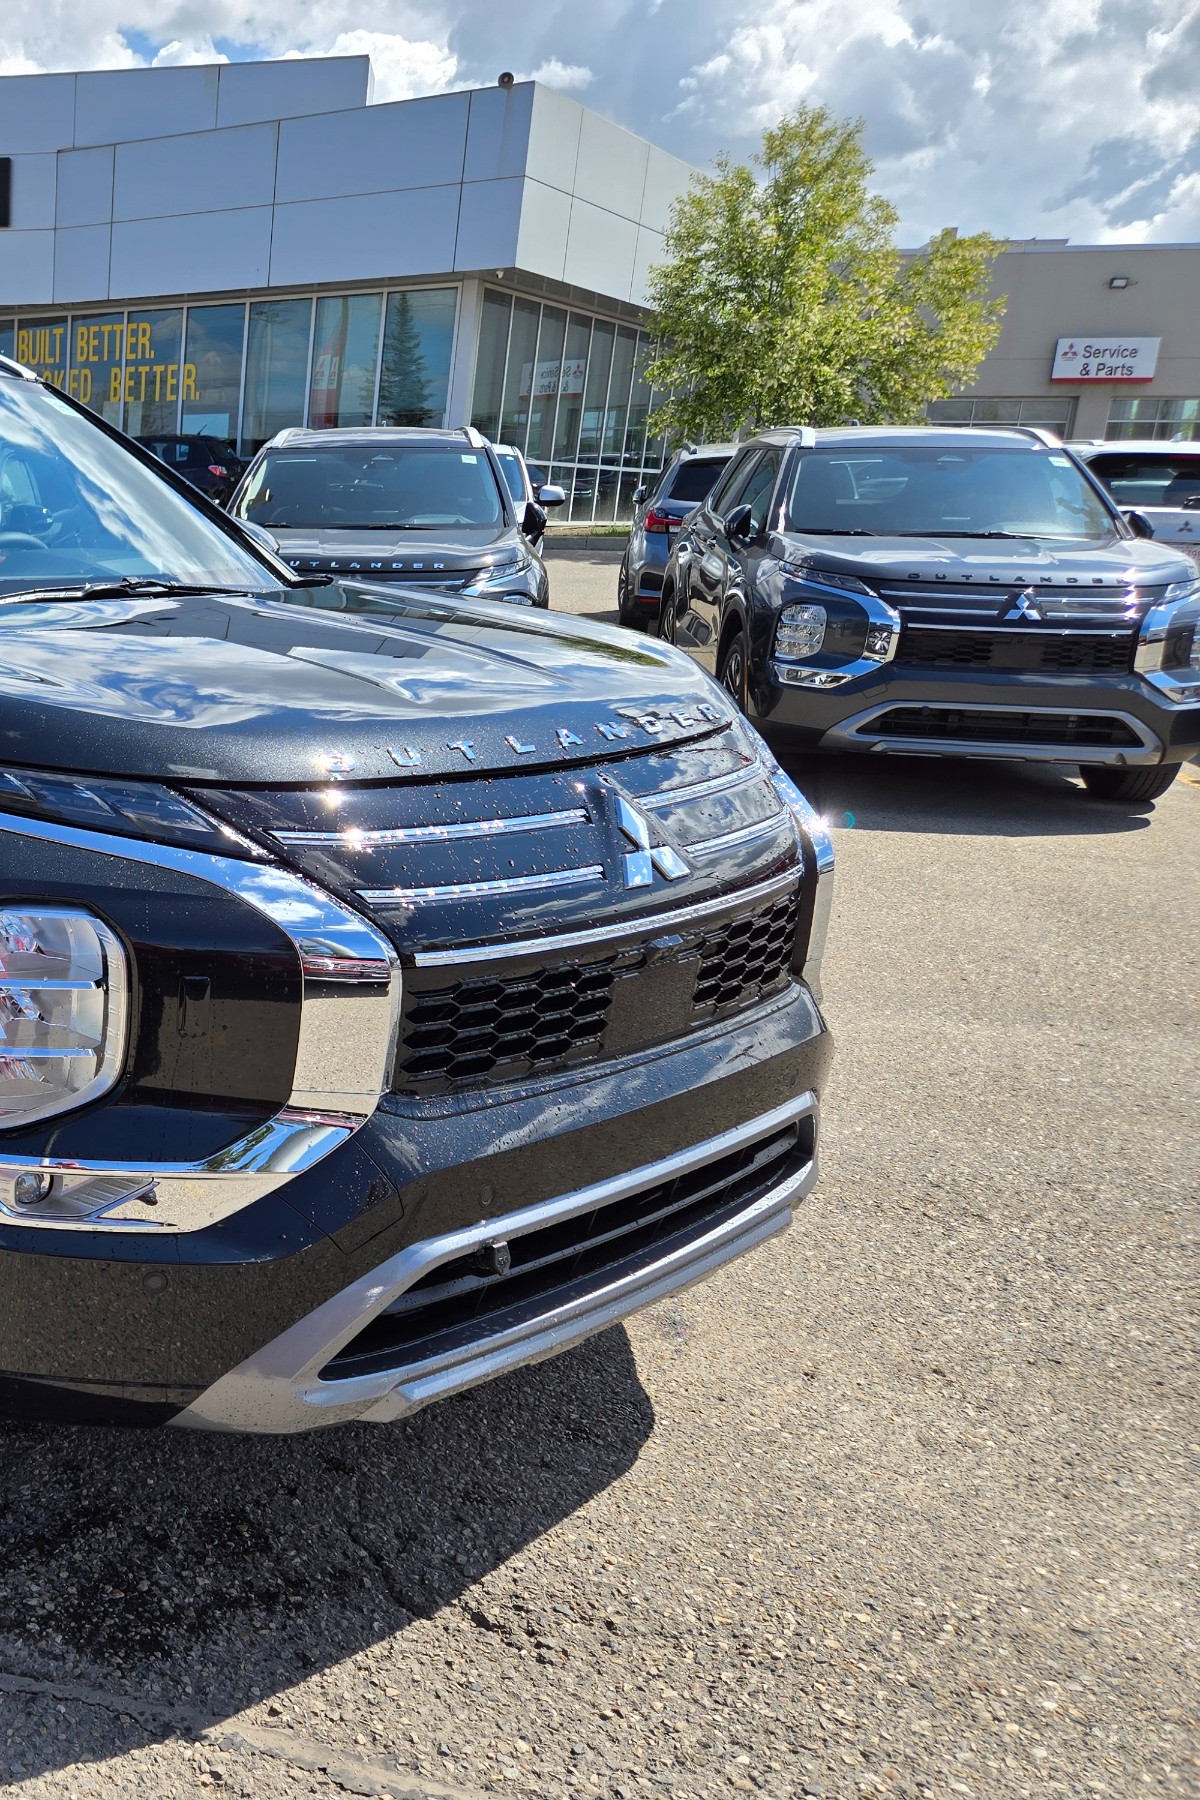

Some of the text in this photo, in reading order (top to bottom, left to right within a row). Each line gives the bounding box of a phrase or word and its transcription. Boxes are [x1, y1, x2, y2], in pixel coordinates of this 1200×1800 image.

[18, 322, 155, 366] BUILT BETTER.
[1082, 344, 1138, 359] Service
[1079, 362, 1134, 376] & Parts
[110, 363, 201, 403] BETTER.
[289, 561, 445, 569] UTLANDER
[319, 703, 722, 773] OUTLANDER
